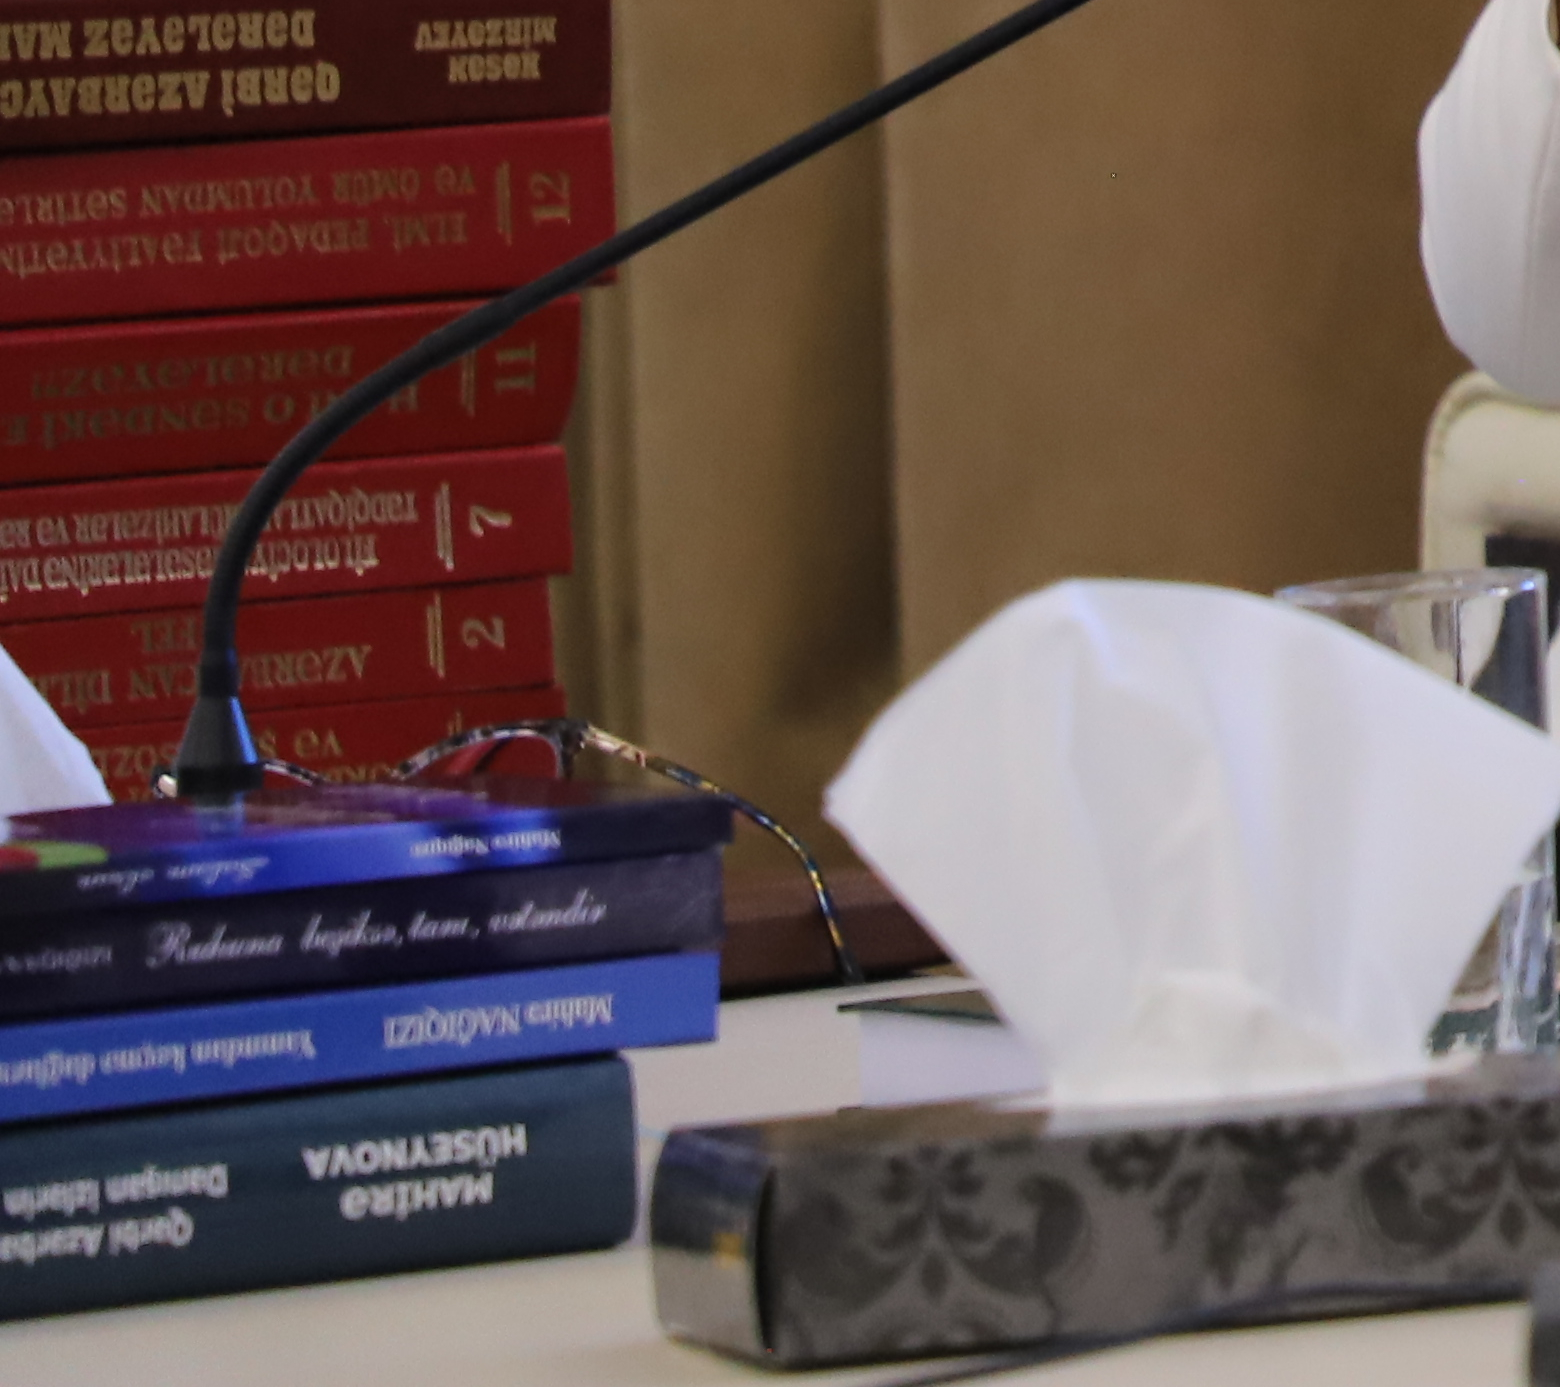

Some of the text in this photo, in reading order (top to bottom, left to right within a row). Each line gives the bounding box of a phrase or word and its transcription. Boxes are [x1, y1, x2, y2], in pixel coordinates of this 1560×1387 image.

[83, 8, 316, 58] DƏRƏLƏYƏZ
[221, 58, 341, 118] QƏRBİ
[139, 173, 318, 219] YOLUMDAN
[460, 616, 505, 651] 2
[129, 644, 372, 701] AZƏRBACAN
[525, 994, 613, 1031] Mahirə
[301, 1122, 528, 1181] HÜSEYNOVA
[339, 1172, 494, 1222] MAHİRƏ
